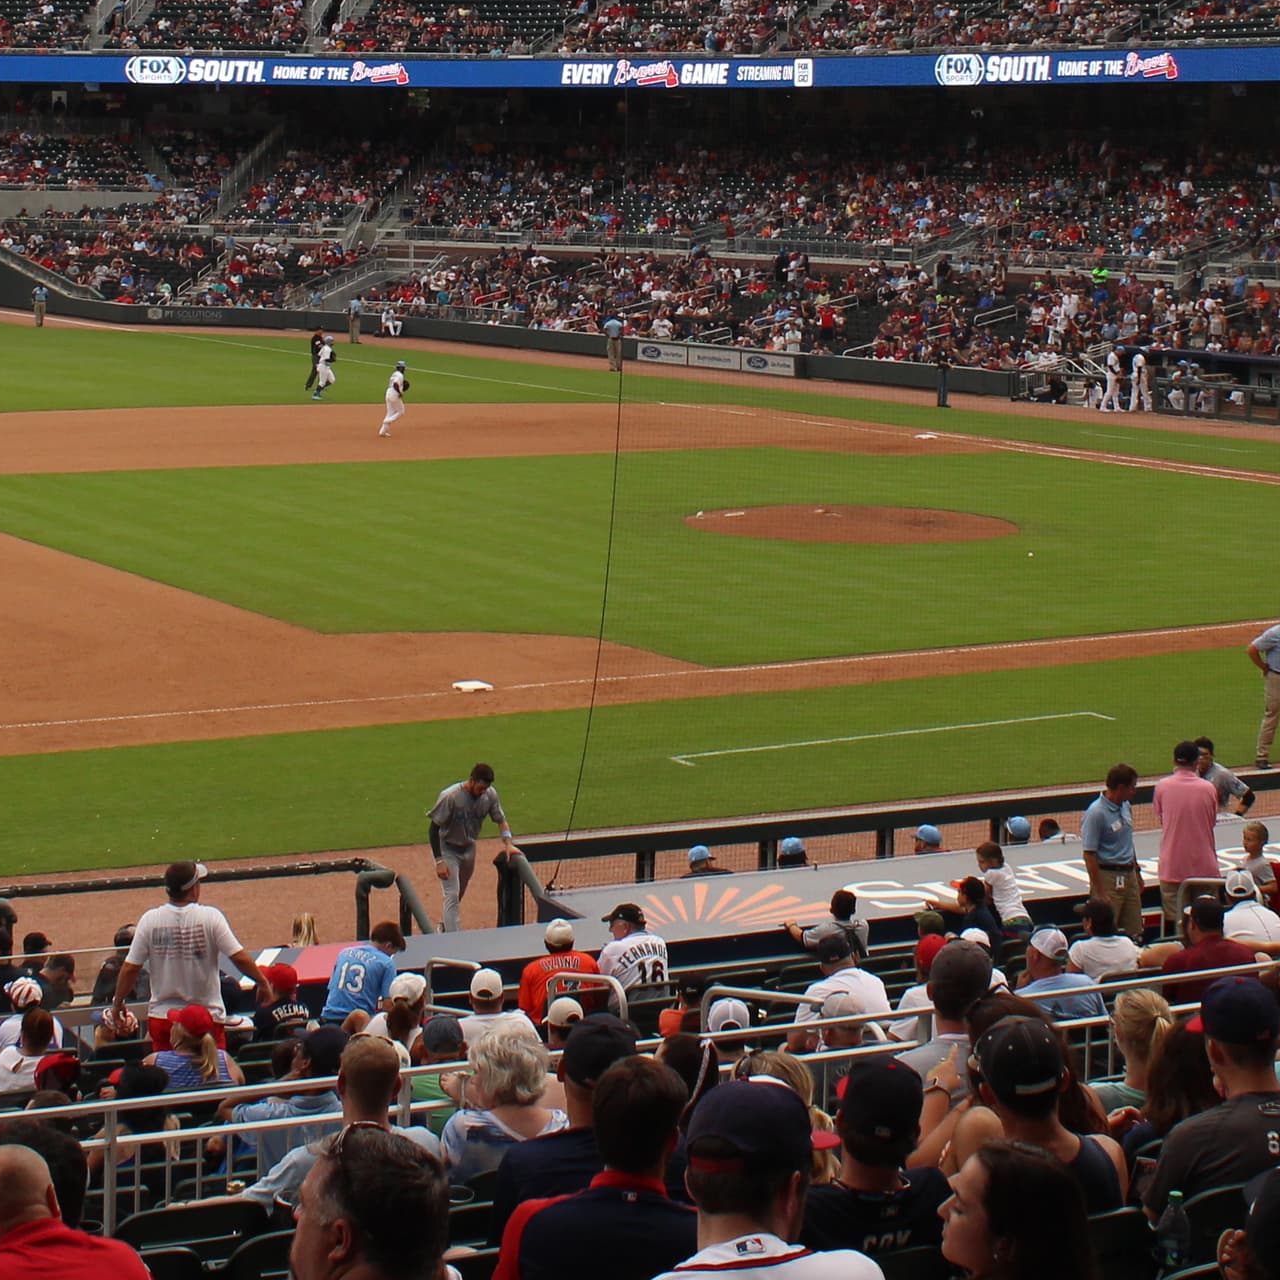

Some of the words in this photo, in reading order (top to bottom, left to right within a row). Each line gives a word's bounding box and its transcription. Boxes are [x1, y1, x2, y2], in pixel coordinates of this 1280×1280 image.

[139, 58, 171, 74] FOX
[273, 65, 307, 80] HOME
[308, 66, 325, 80] OF
[327, 66, 350, 81] THE
[561, 63, 614, 84] EVERY
[680, 63, 729, 85] GAME
[737, 65, 782, 82] STREAMING
[783, 65, 793, 81] ON
[946, 57, 972, 74] FOX
[1058, 60, 1088, 77] HOME
[1090, 60, 1102, 76] OF
[1104, 59, 1124, 76] THE
[338, 962, 366, 993] 13
[638, 960, 665, 985] 16
[272, 1003, 309, 1022] FREEMAN
